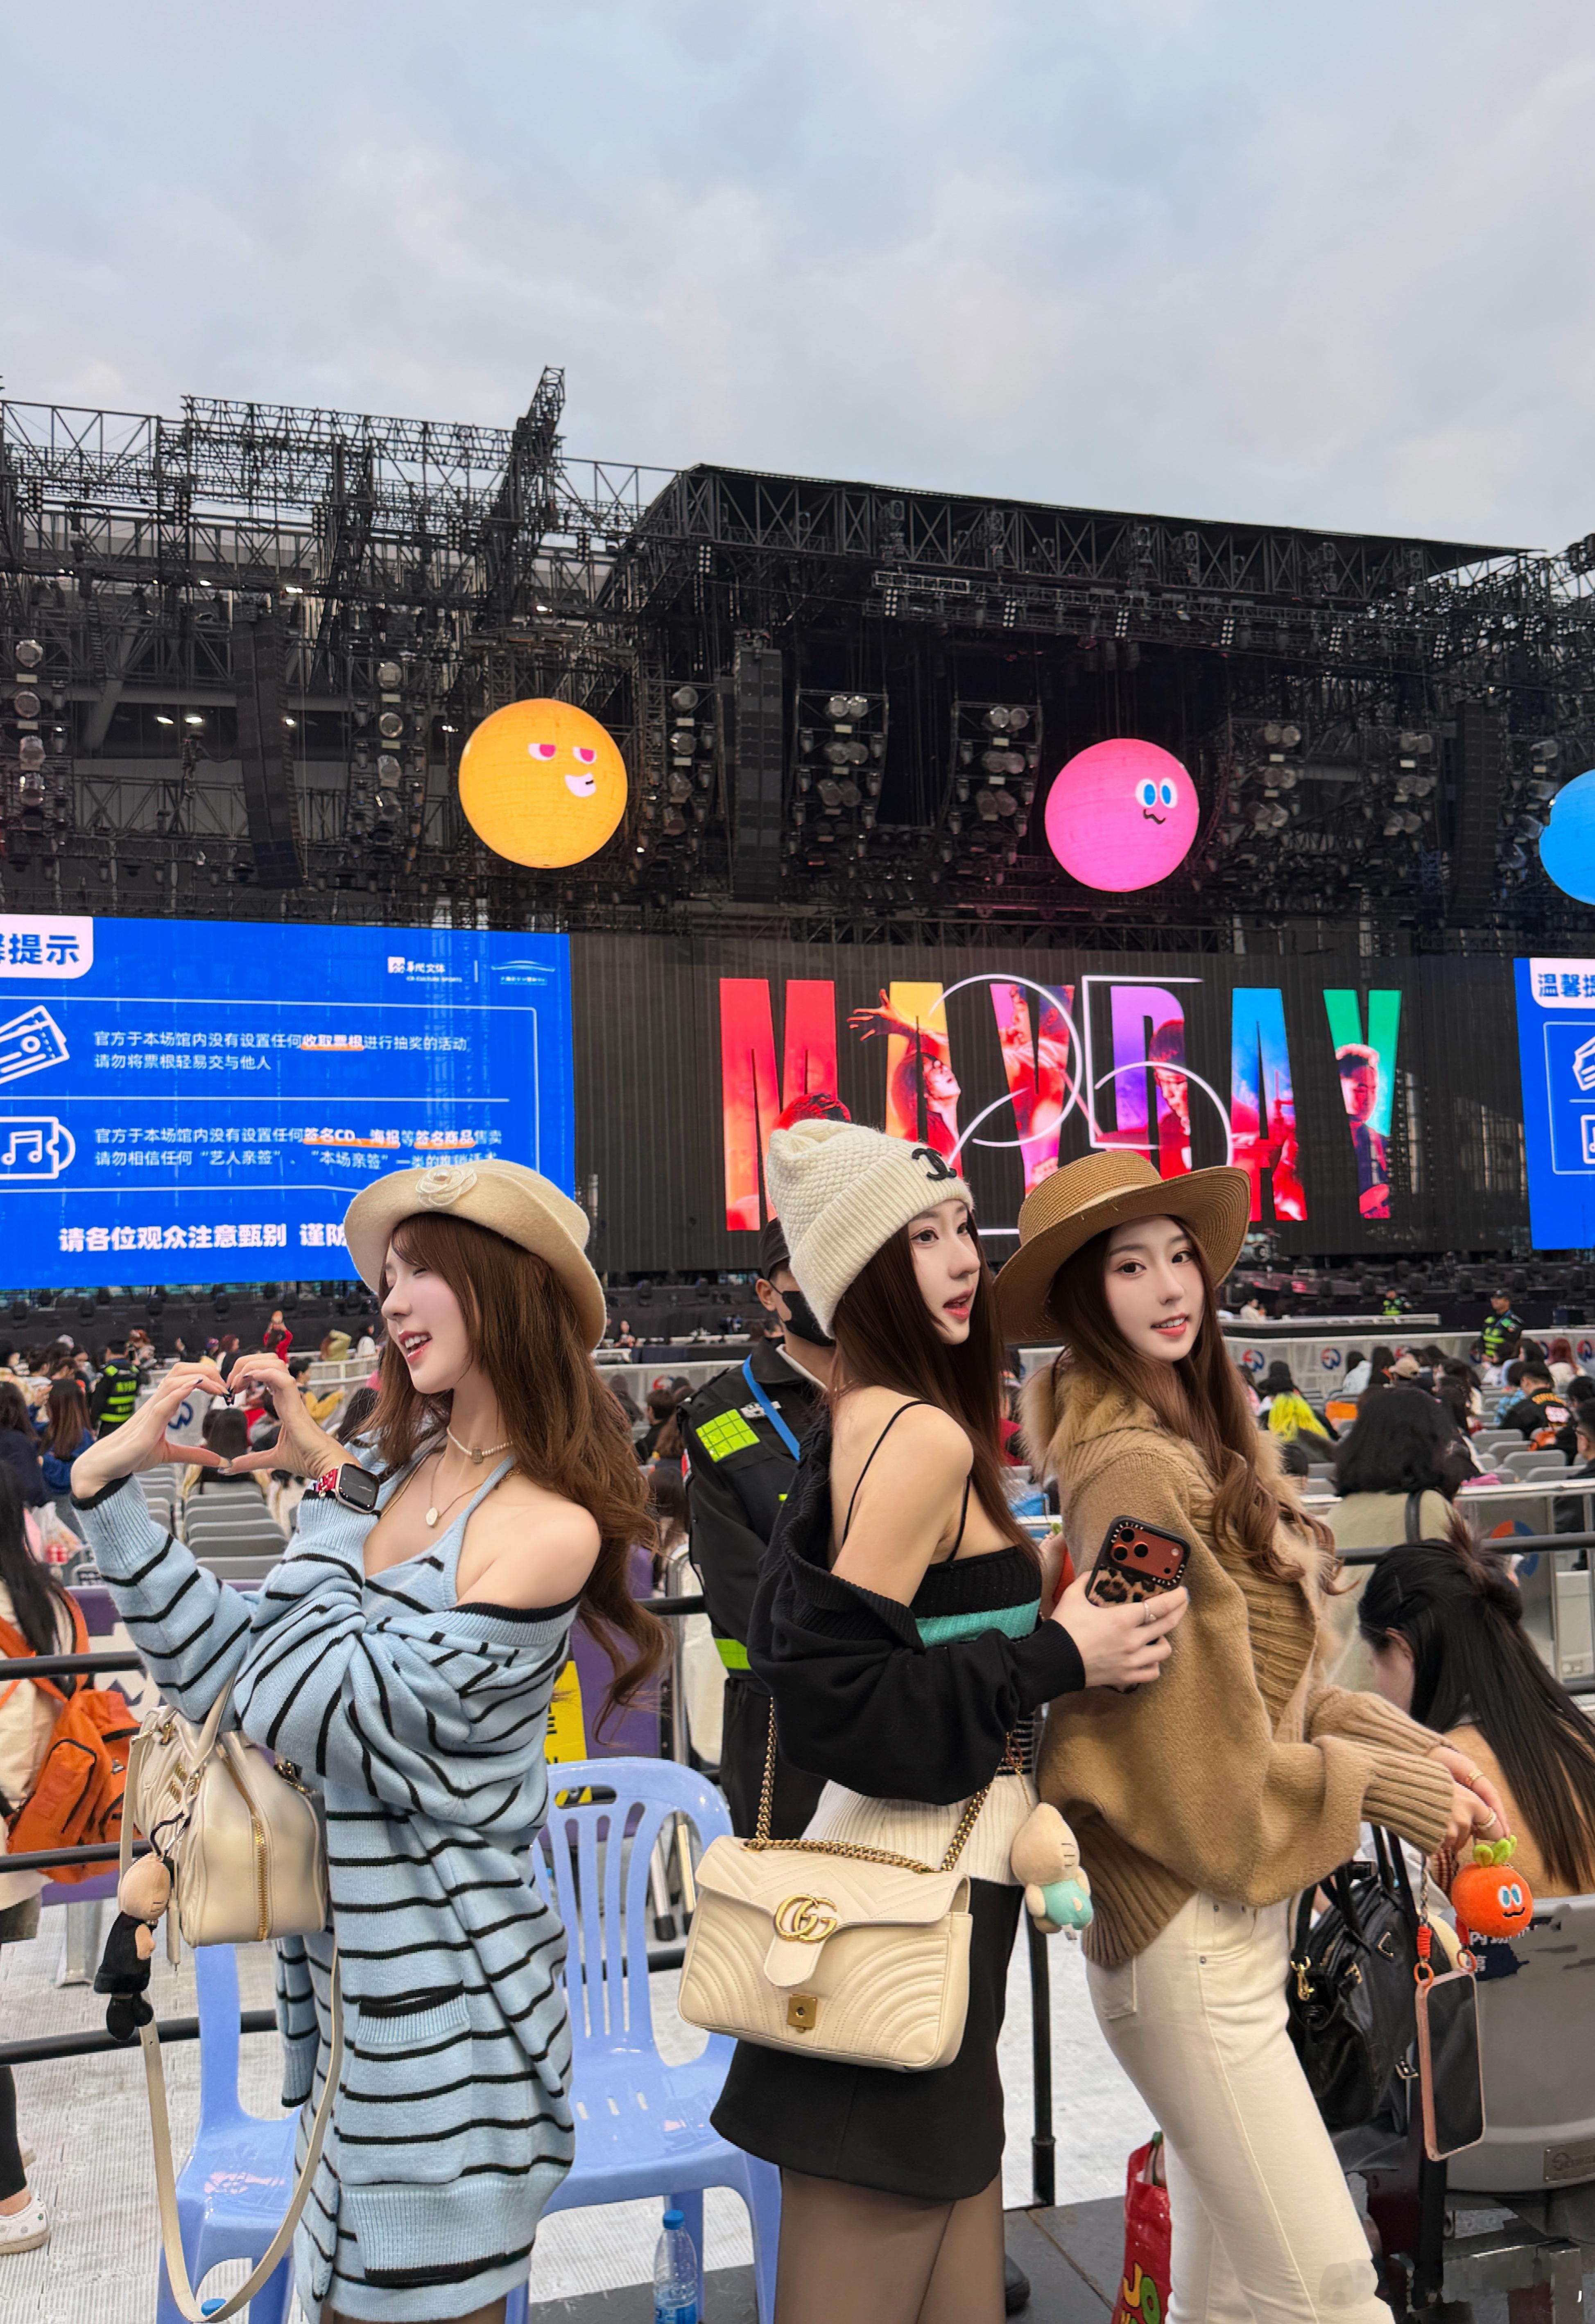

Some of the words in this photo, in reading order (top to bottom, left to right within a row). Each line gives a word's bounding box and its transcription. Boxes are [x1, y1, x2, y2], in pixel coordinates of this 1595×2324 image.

[0, 933, 79, 965] 提示
[94, 1030, 468, 1051] 官方于本场馆内没有设置任何收取票根进行抽奖的活动
[95, 1053, 271, 1070] 请勿将票根轻易交与他人
[58, 1223, 287, 1252] 请各位观众注意甄别
